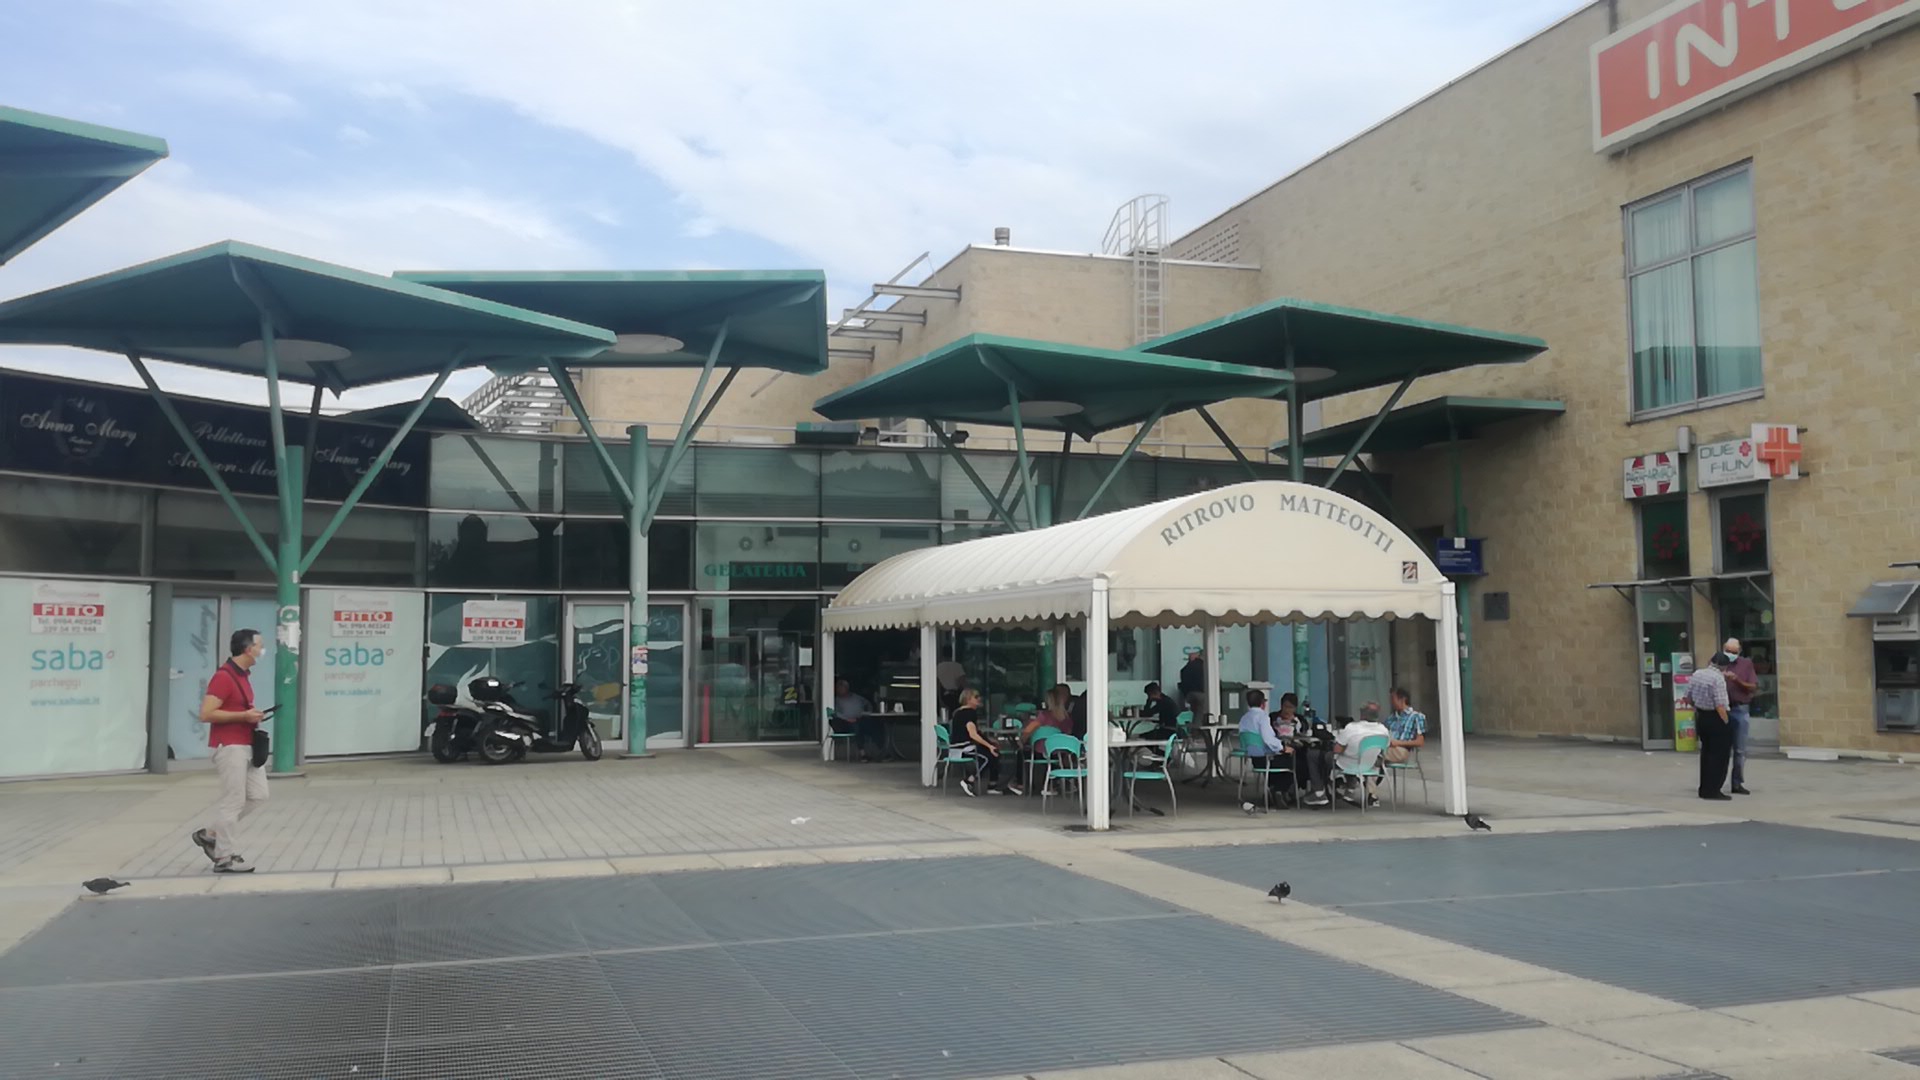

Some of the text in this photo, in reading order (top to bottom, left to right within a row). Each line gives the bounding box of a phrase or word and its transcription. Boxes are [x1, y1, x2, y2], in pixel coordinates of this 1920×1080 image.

[20, 410, 75, 433] Anna
[85, 417, 138, 448] Mary
[1699, 443, 1734, 459] DUE
[314, 446, 412, 476] Anna ary
[1711, 456, 1754, 474] FIUM
[1159, 493, 1396, 554] RITROVO MATTEOTTI
[704, 563, 807, 578] GELATERIA
[41, 604, 98, 616] FITTO
[341, 611, 387, 622] FITTO
[471, 618, 518, 628] FITTO
[31, 642, 103, 671] saba
[324, 641, 385, 666] saba
[30, 677, 81, 690] parcheggi
[324, 671, 366, 682] parcheggi
